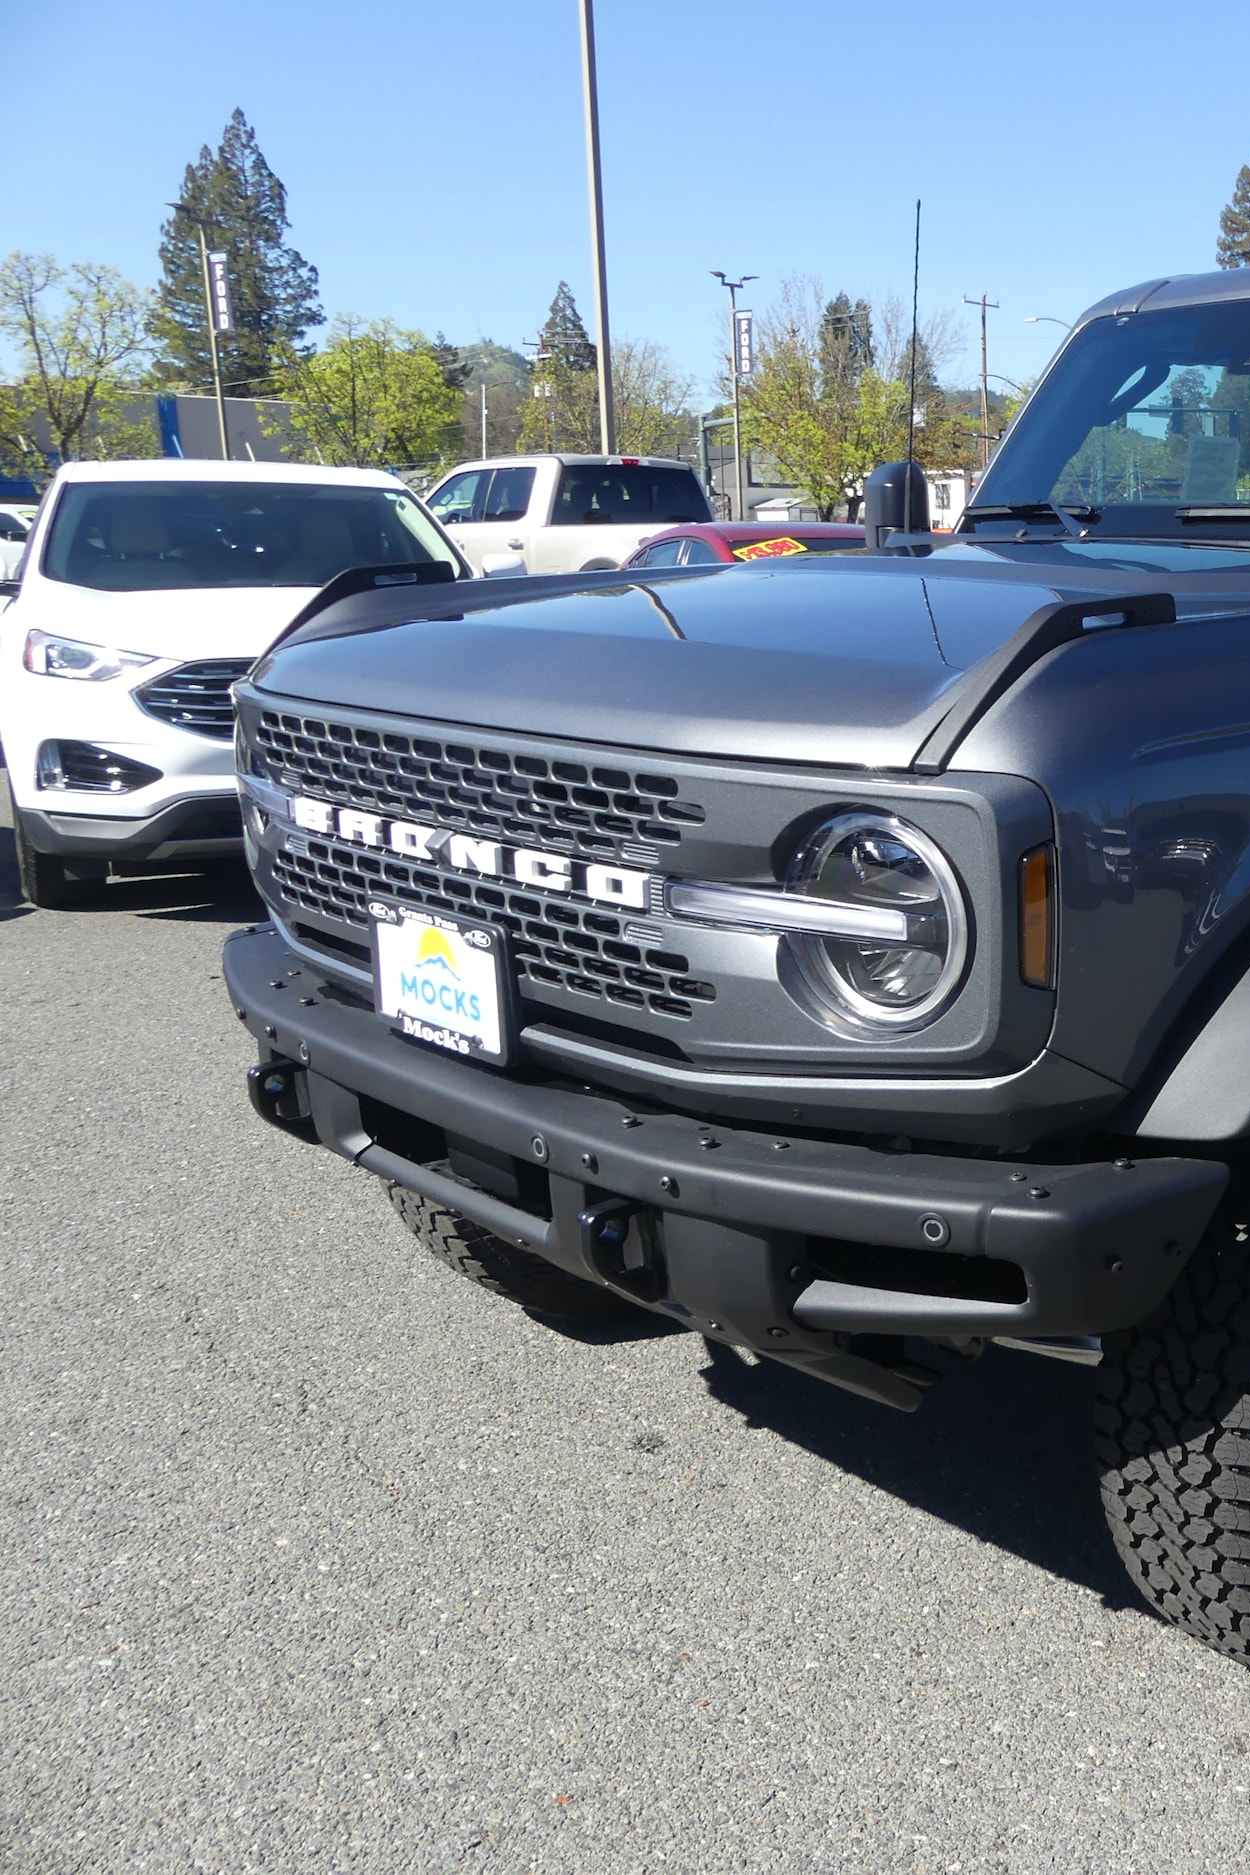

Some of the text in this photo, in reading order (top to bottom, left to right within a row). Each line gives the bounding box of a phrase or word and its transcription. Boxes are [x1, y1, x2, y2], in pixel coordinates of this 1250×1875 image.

[215, 263, 229, 330] FORD
[741, 319, 750, 373] FORD
[295, 798, 650, 910] BRONCO
[398, 906, 459, 932] Grants Pass
[401, 971, 481, 1021] MOCKS
[403, 1016, 471, 1055] Mock's
